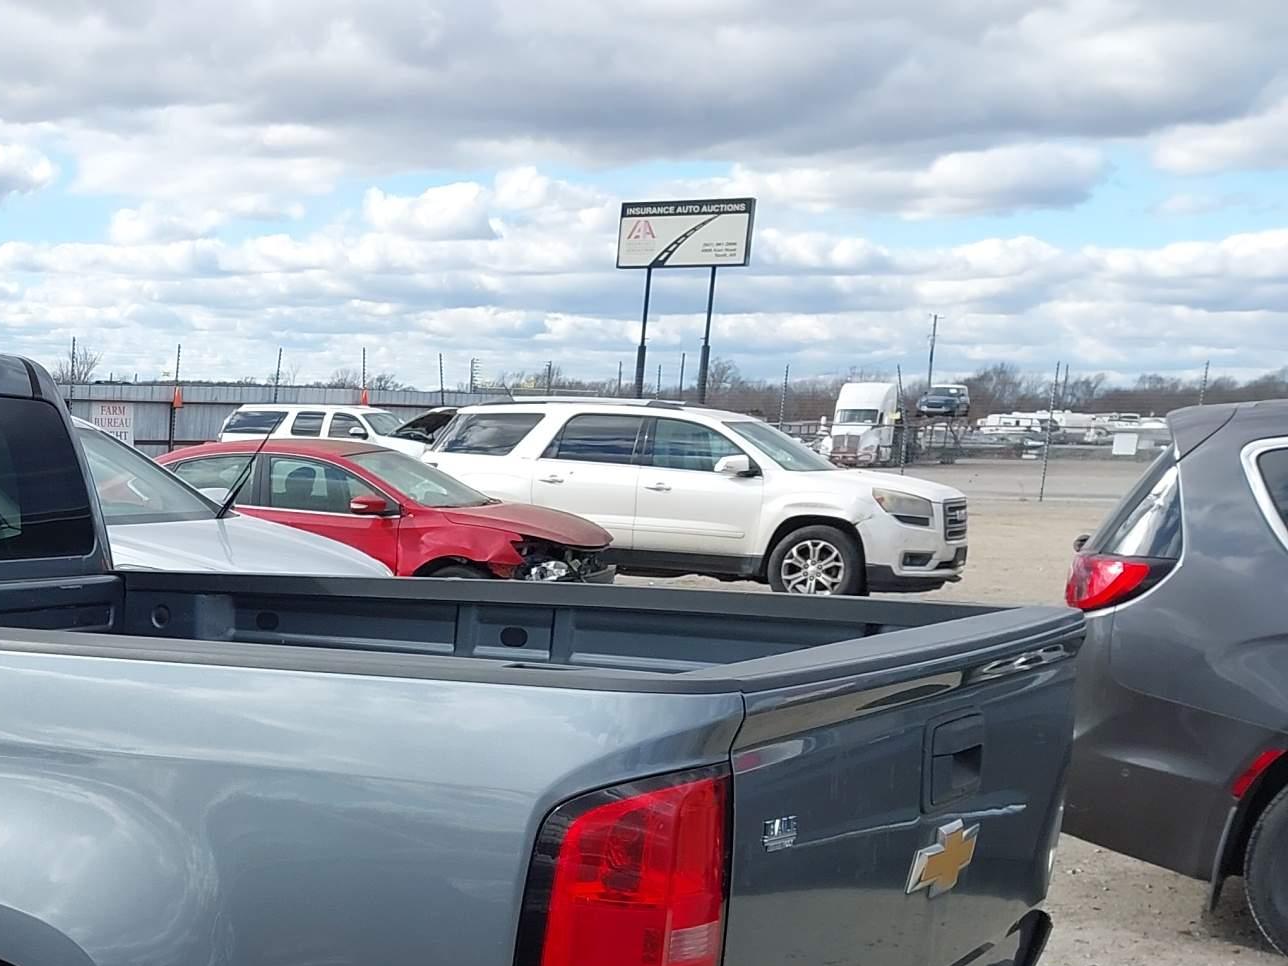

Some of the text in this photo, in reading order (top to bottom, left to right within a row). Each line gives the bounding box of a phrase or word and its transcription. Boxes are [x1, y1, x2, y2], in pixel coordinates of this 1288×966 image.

[626, 203, 746, 216] INSURANCE AUTO AUCTIONS
[101, 405, 126, 416] FARM
[94, 417, 132, 428] BUREAU
